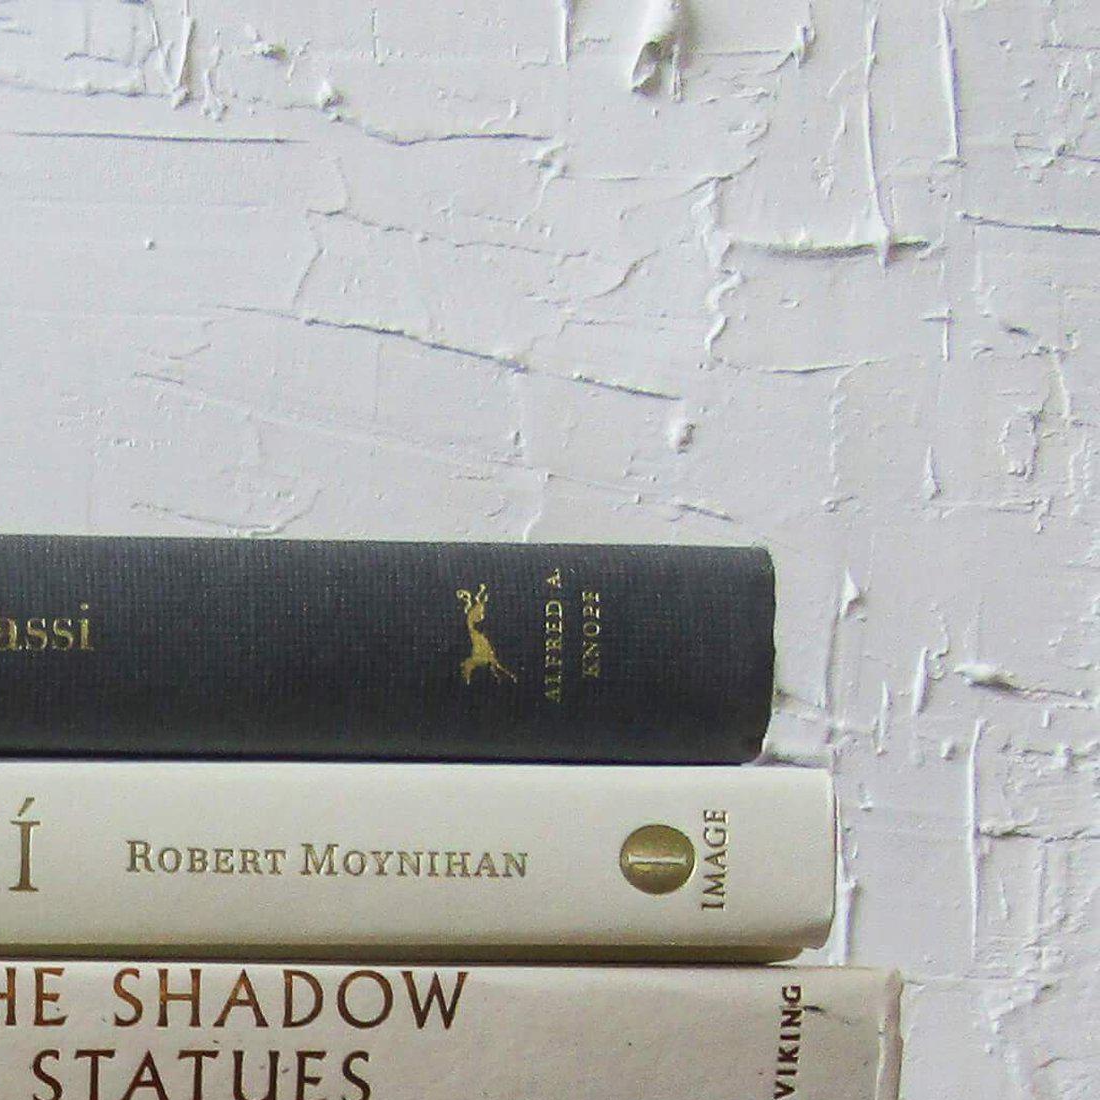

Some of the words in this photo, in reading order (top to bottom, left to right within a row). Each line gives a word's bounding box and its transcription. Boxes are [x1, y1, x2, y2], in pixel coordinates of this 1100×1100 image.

[545, 600, 563, 702] ALFRED
[701, 809, 728, 911] IMAGE
[113, 968, 470, 1030] SHADOW
[774, 985, 800, 1099] VIKING
